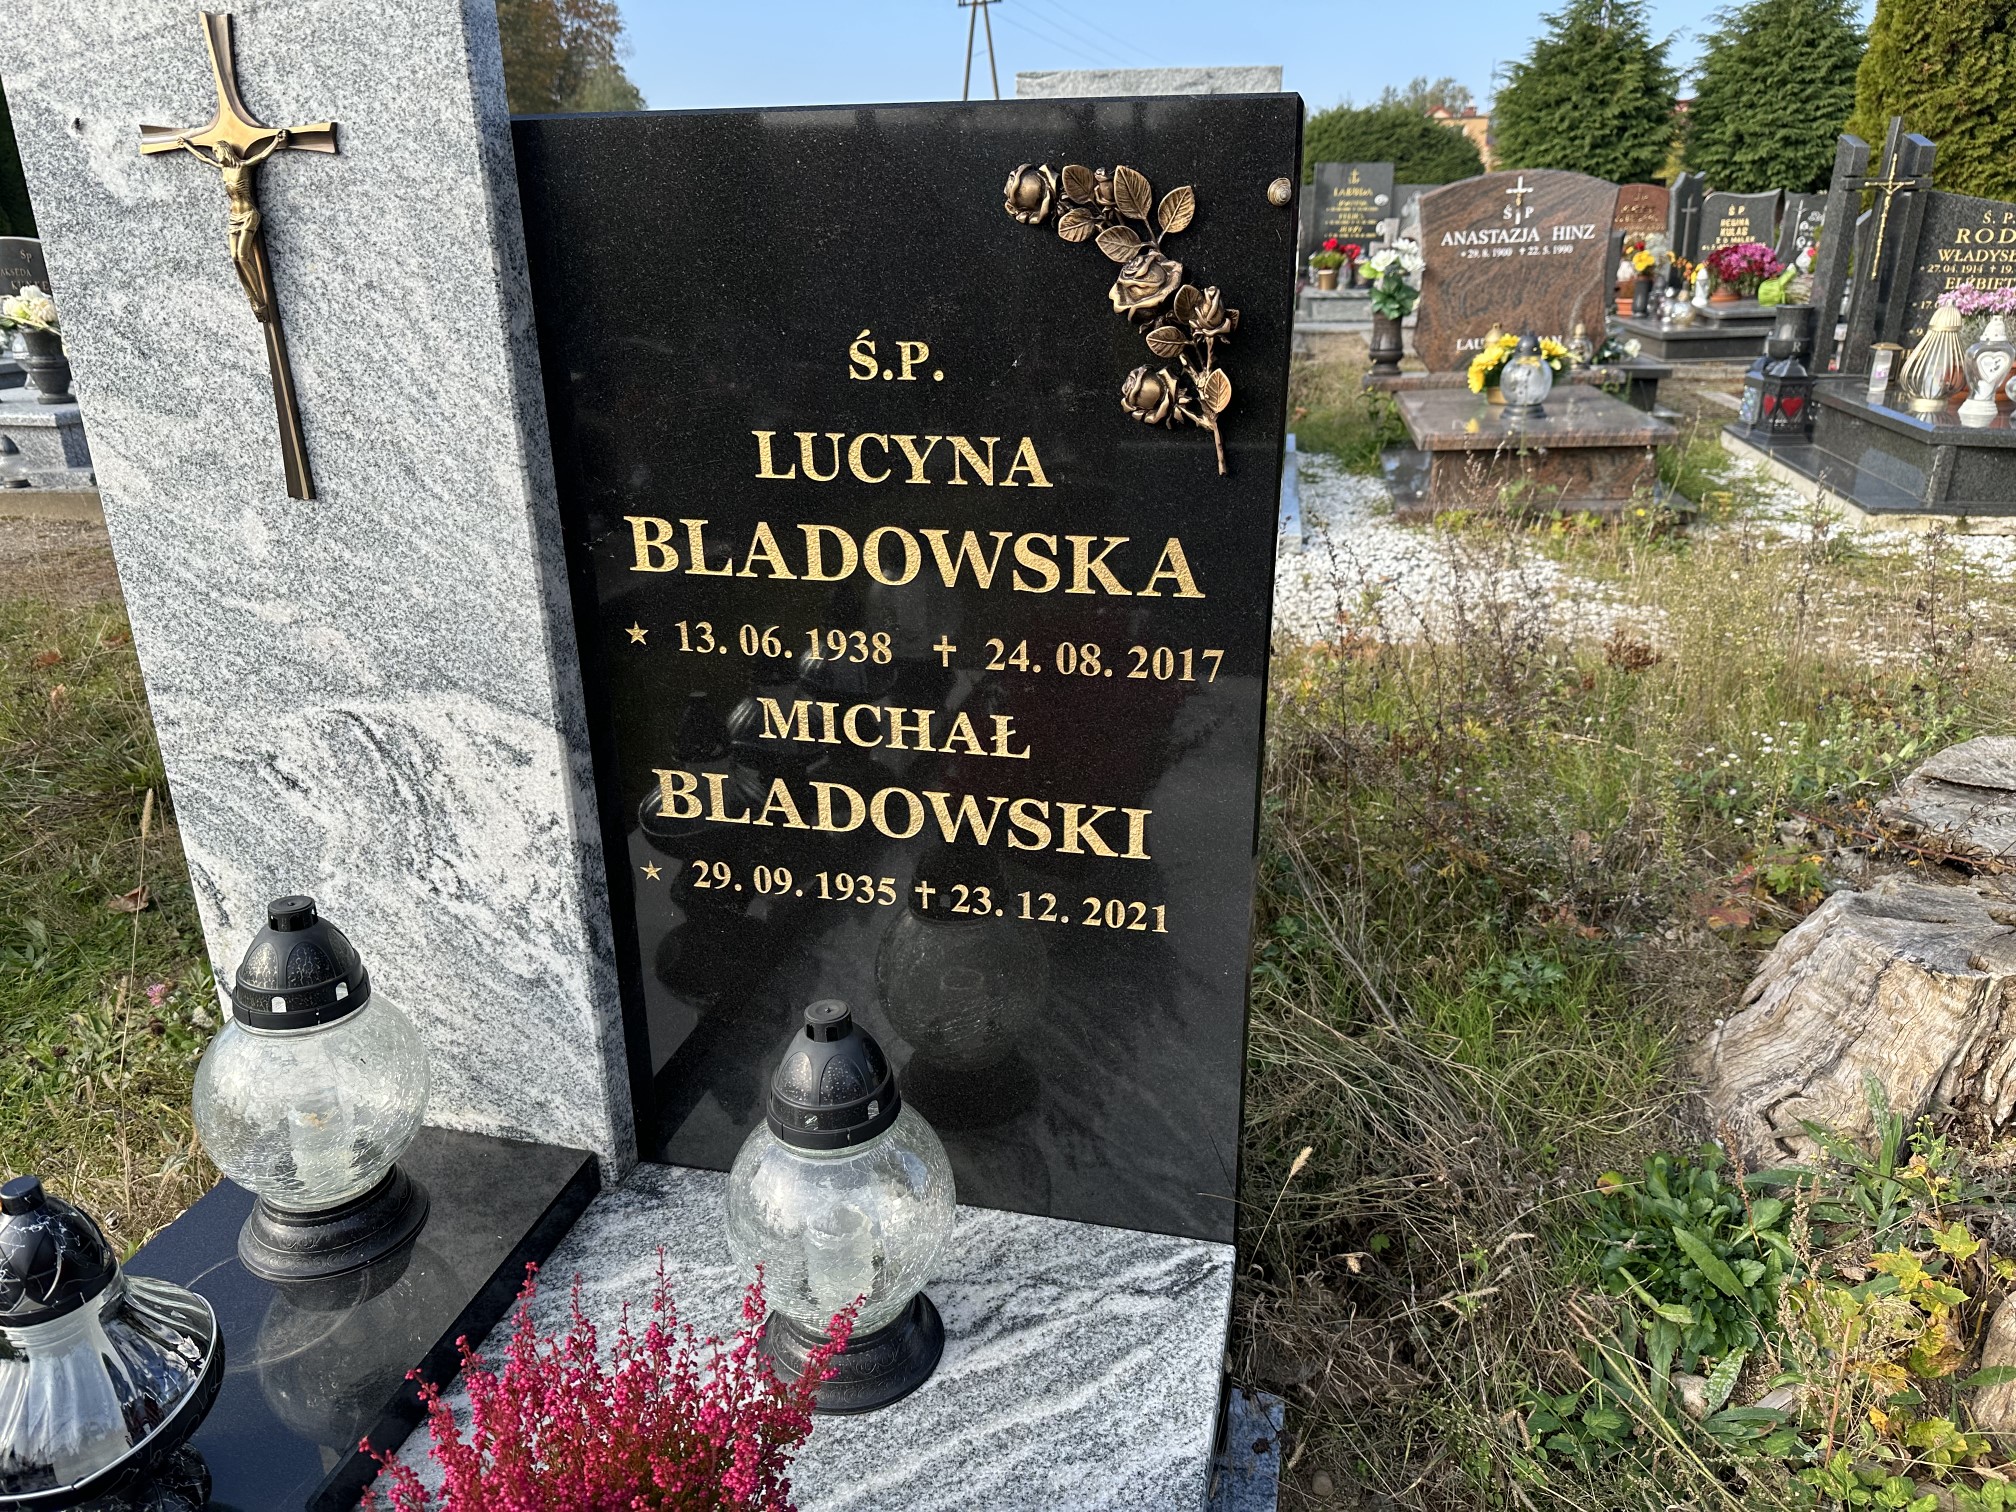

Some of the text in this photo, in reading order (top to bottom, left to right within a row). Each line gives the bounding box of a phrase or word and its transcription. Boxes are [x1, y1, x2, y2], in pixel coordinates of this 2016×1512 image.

[1441, 223, 1596, 247] ANASTAZJA HINZ
[848, 329, 945, 382] Ś.P.
[1792, 341, 1801, 353] R
[752, 429, 1053, 488] LUCYNA
[623, 515, 1206, 599] BLADOWSKA
[674, 620, 1225, 684] 13. 06. 1938 24. 08. 2017
[757, 697, 1031, 760] MICHAŁ
[651, 768, 1153, 861] BLADOWSKI
[692, 860, 1169, 934] 29. 09. 1935 23. 12. 2021
